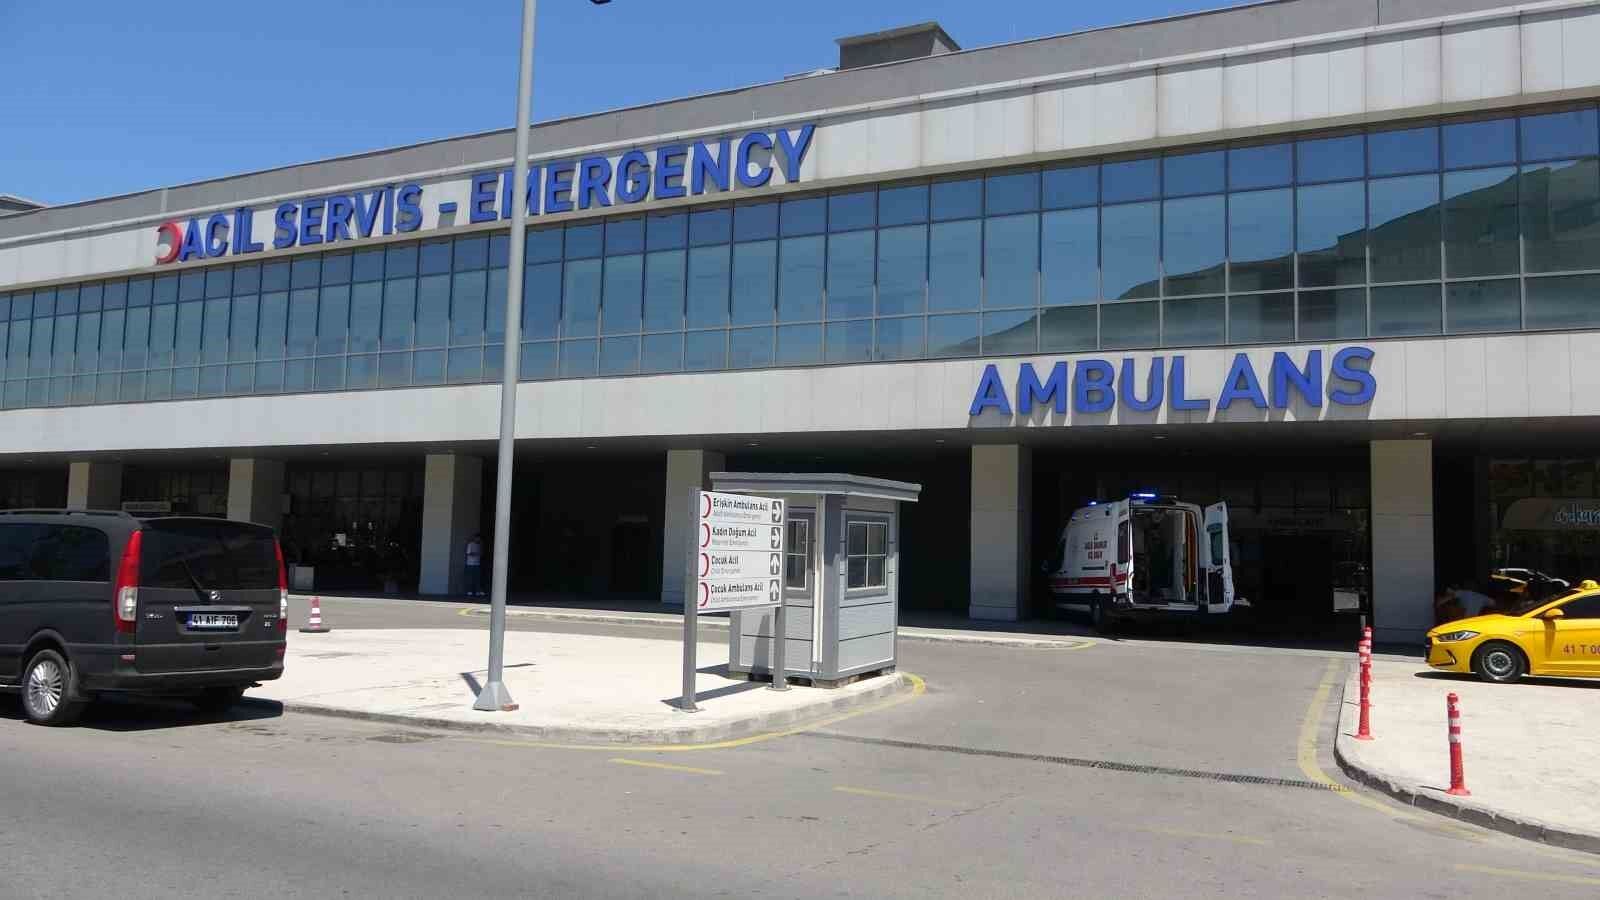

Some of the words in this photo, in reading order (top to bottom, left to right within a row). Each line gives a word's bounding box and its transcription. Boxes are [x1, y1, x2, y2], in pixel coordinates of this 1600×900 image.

[178, 207, 264, 262] ACİL
[273, 182, 423, 250] SERVİS
[438, 201, 457, 214] -
[470, 124, 816, 223] EMERGENCY
[969, 345, 1377, 416] AMBULANS
[733, 500, 759, 511] Ambulans
[747, 527, 757, 537] Acil
[728, 555, 739, 565] Acil
[727, 583, 754, 593] Ambulans
[193, 615, 202, 625] 41
